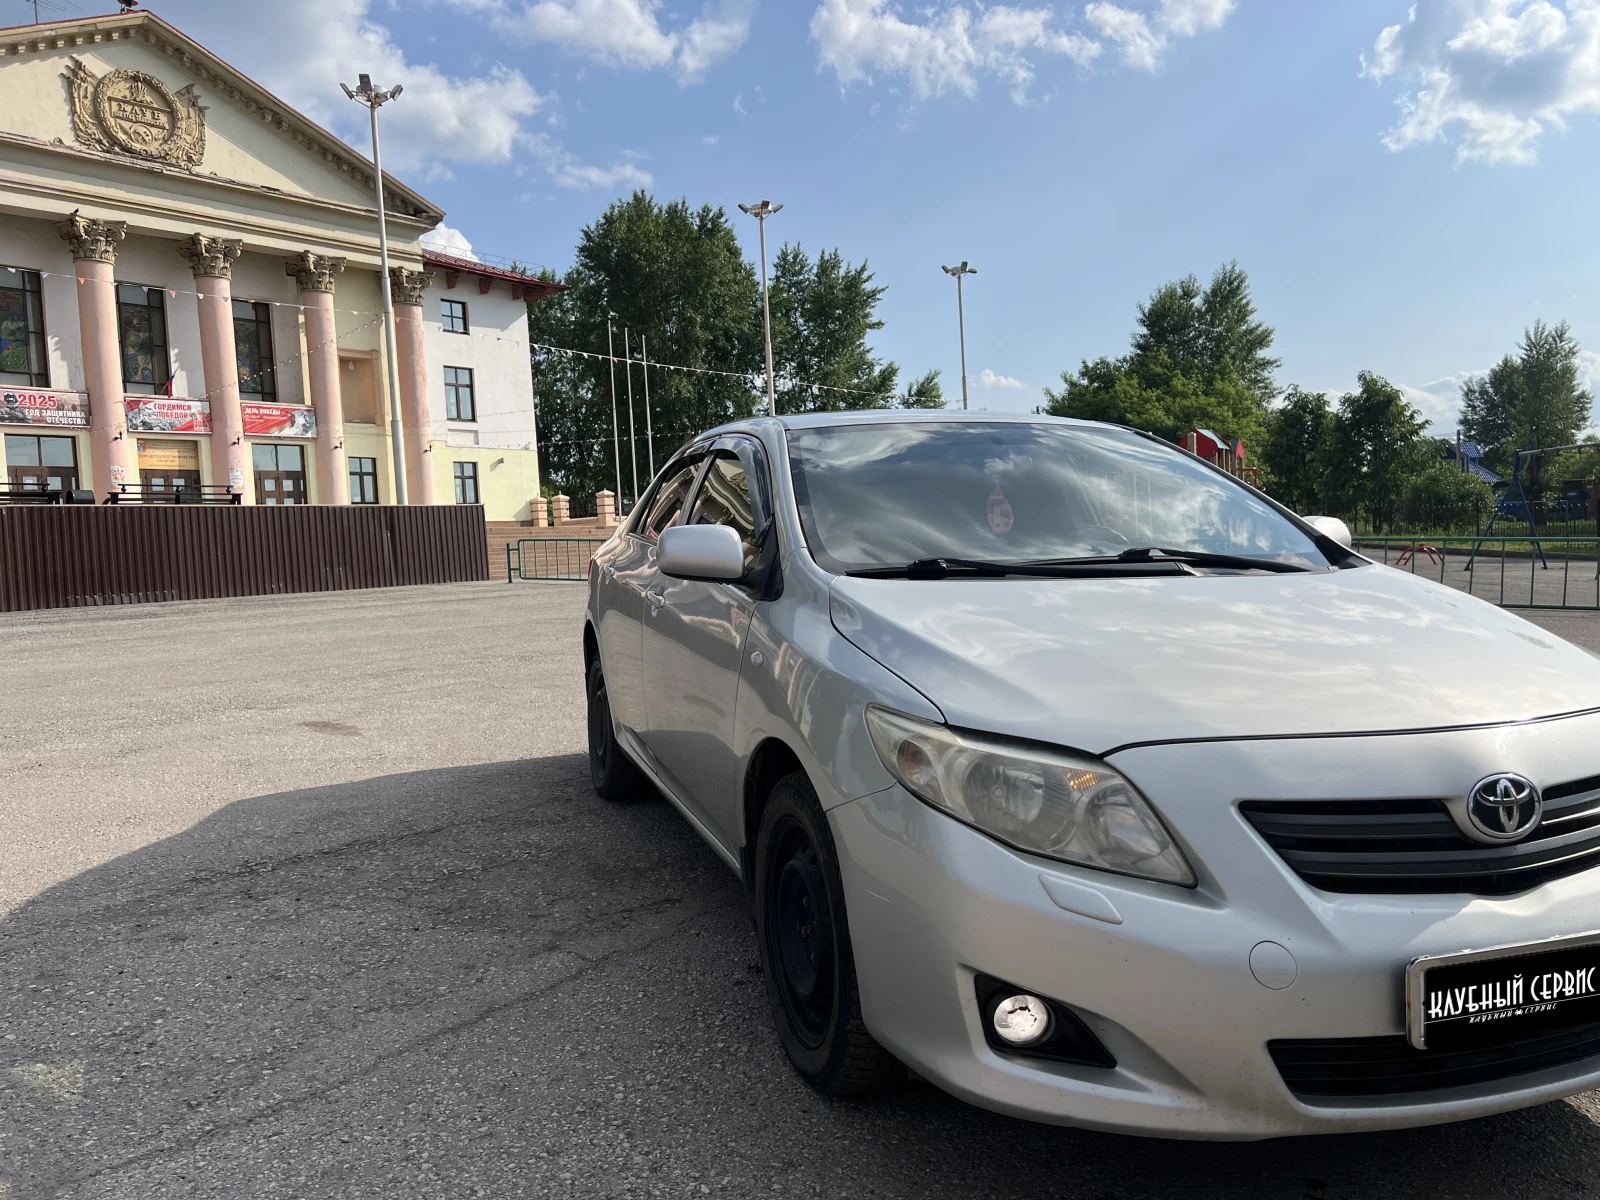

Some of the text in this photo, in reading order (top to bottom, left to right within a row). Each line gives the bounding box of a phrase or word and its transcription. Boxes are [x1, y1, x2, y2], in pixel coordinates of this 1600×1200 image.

[18, 394, 57, 408] 2025
[154, 403, 192, 411] ГОРДИМСЯ
[41, 409, 86, 417] ЗАЩИТНИКА
[156, 411, 190, 419] ПОБЕДОЙ
[46, 417, 87, 425] ОТЕЧЕСТВА
